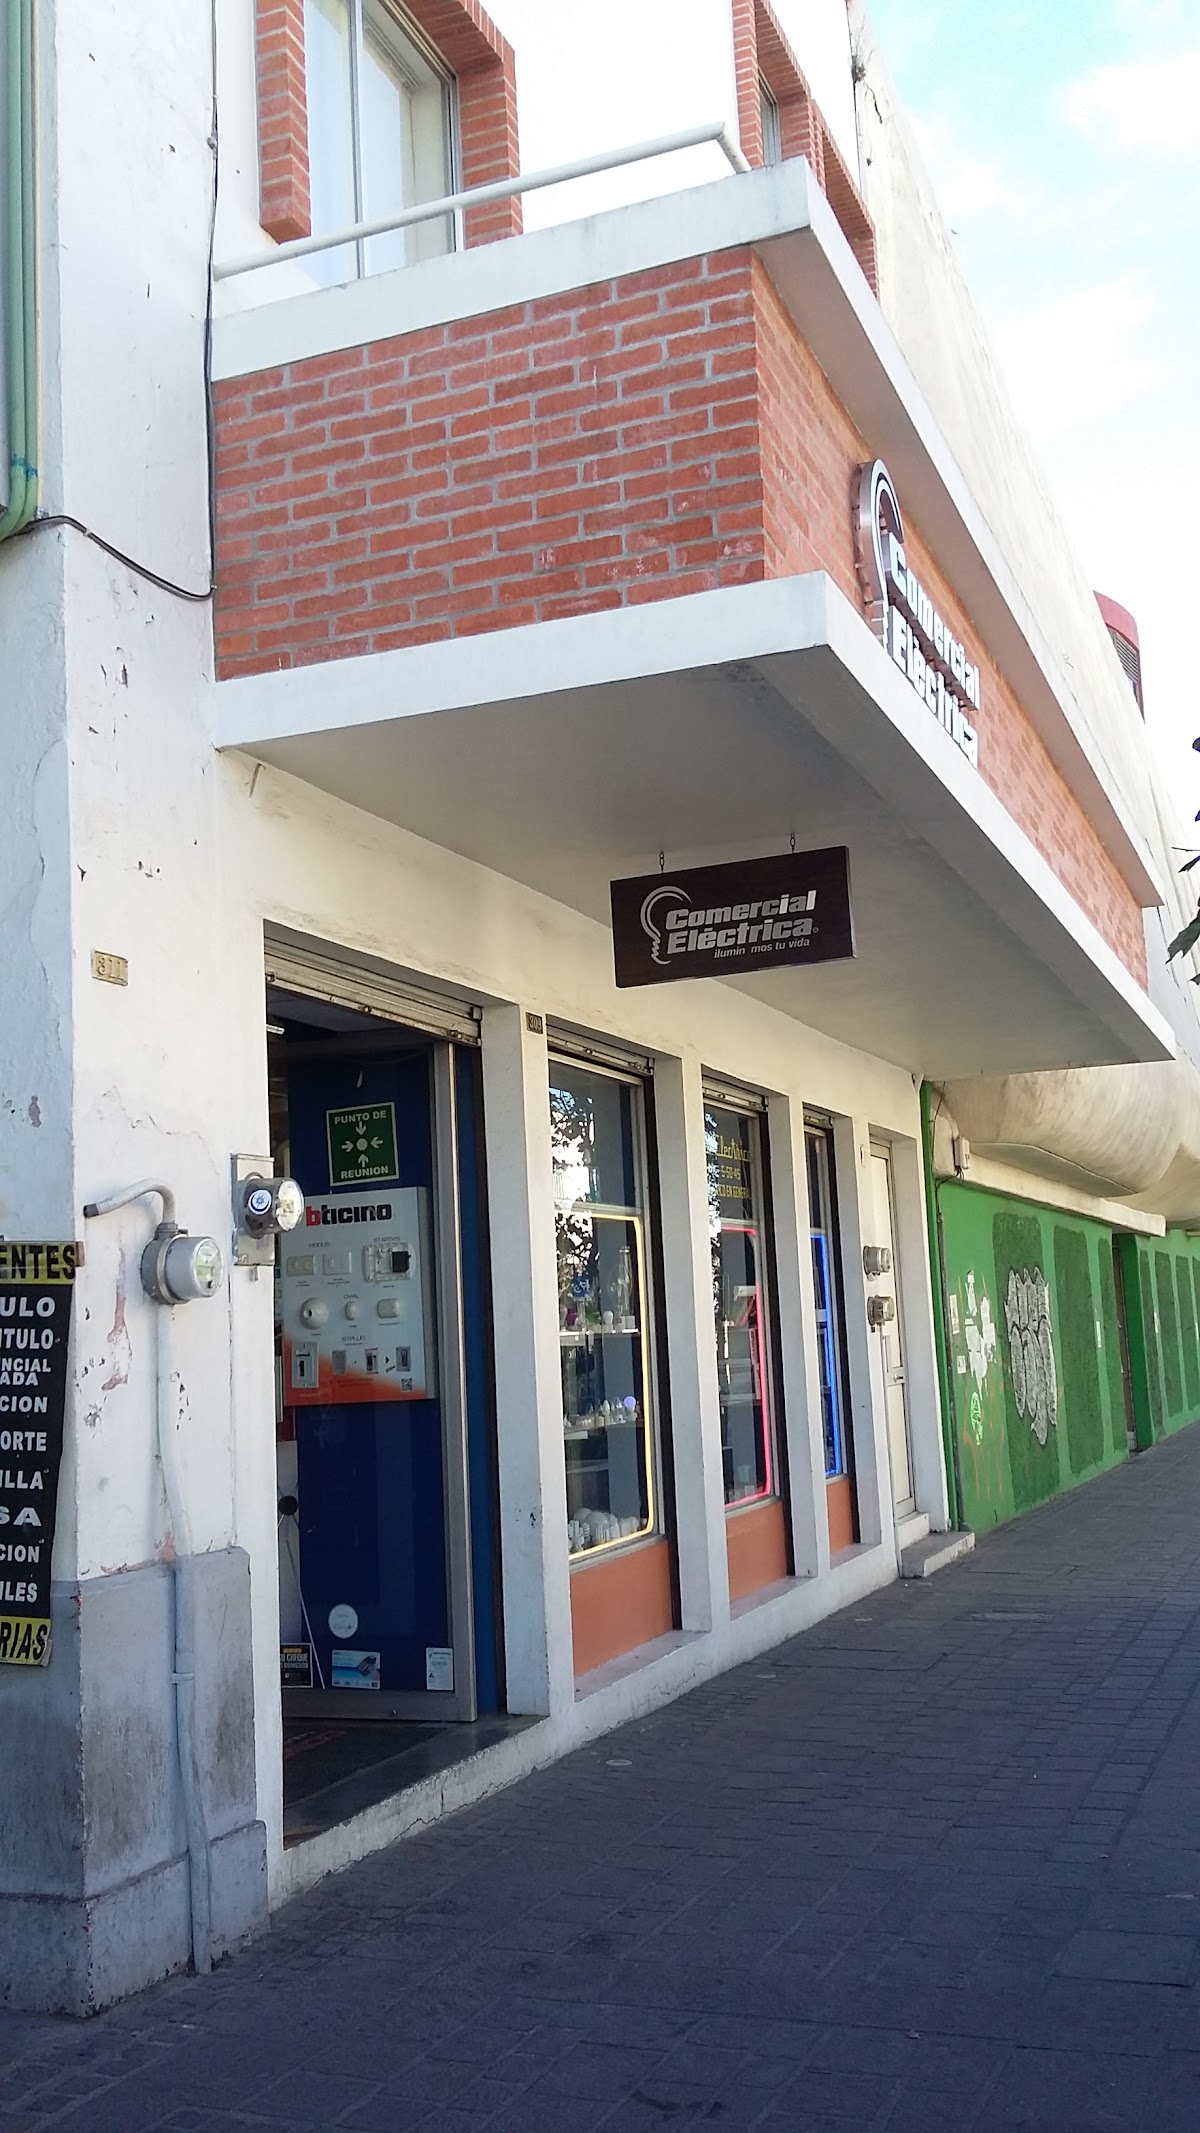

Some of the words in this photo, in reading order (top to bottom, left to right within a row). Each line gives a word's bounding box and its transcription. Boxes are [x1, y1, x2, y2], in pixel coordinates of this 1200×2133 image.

[889, 532, 980, 710] Comercial
[666, 890, 817, 930] Comercial
[775, 941, 786, 950] tu
[788, 938, 810, 948] vida
[334, 1112, 370, 1124] PUNTO
[373, 1110, 387, 1119] DE
[340, 1166, 389, 1179] REUNION
[306, 1204, 392, 1226] bticino
[0, 1430, 47, 1451] ORTE
